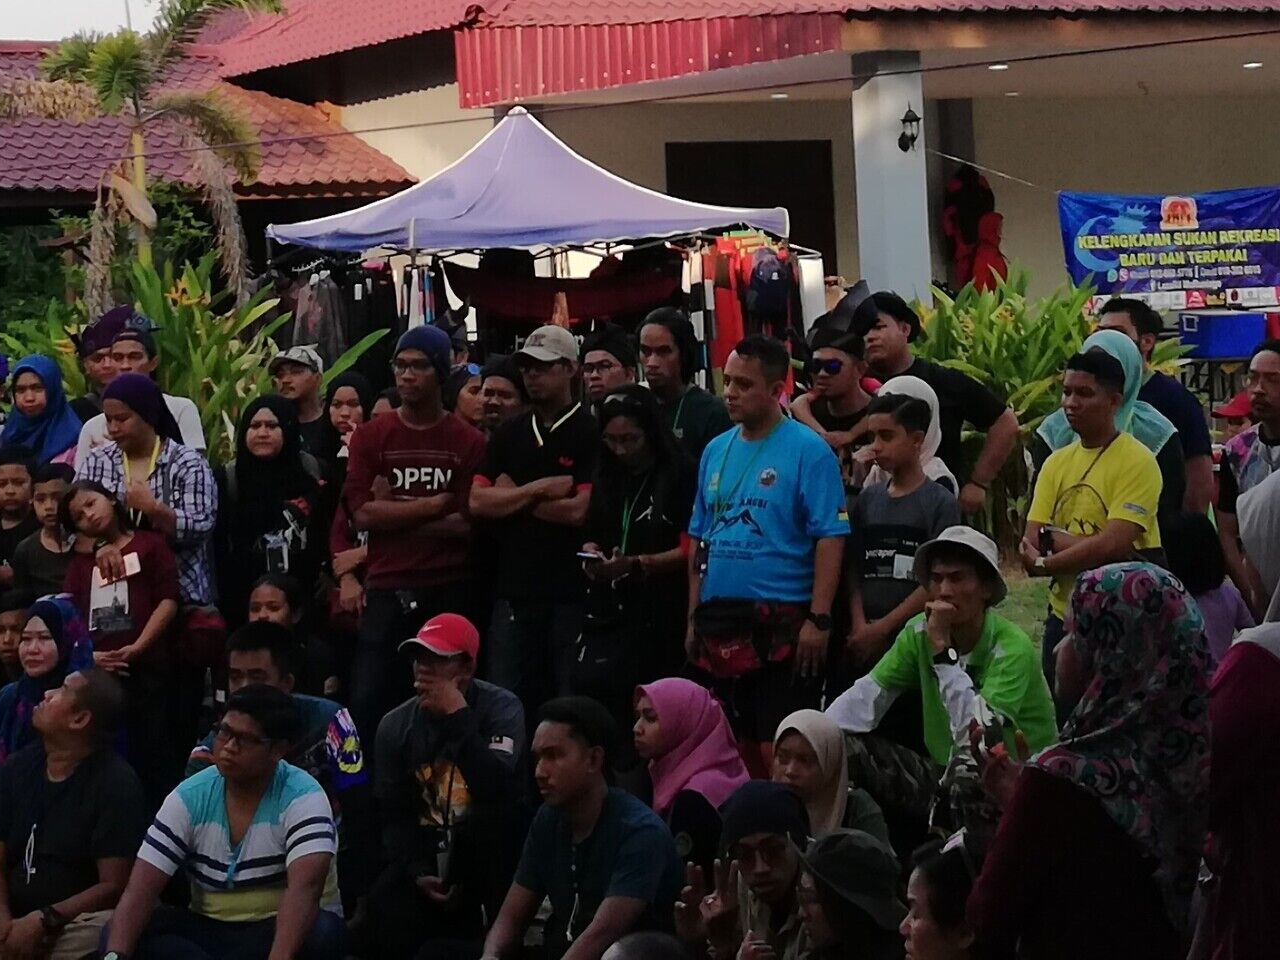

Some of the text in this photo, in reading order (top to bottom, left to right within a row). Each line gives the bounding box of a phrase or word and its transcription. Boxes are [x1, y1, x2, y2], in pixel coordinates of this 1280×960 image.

[1077, 228, 1280, 249] KELENGKAPAN SUKAN REKREASI
[1120, 248, 1248, 267] BARU DAN TERPAKAI
[391, 466, 453, 491] OPEN
